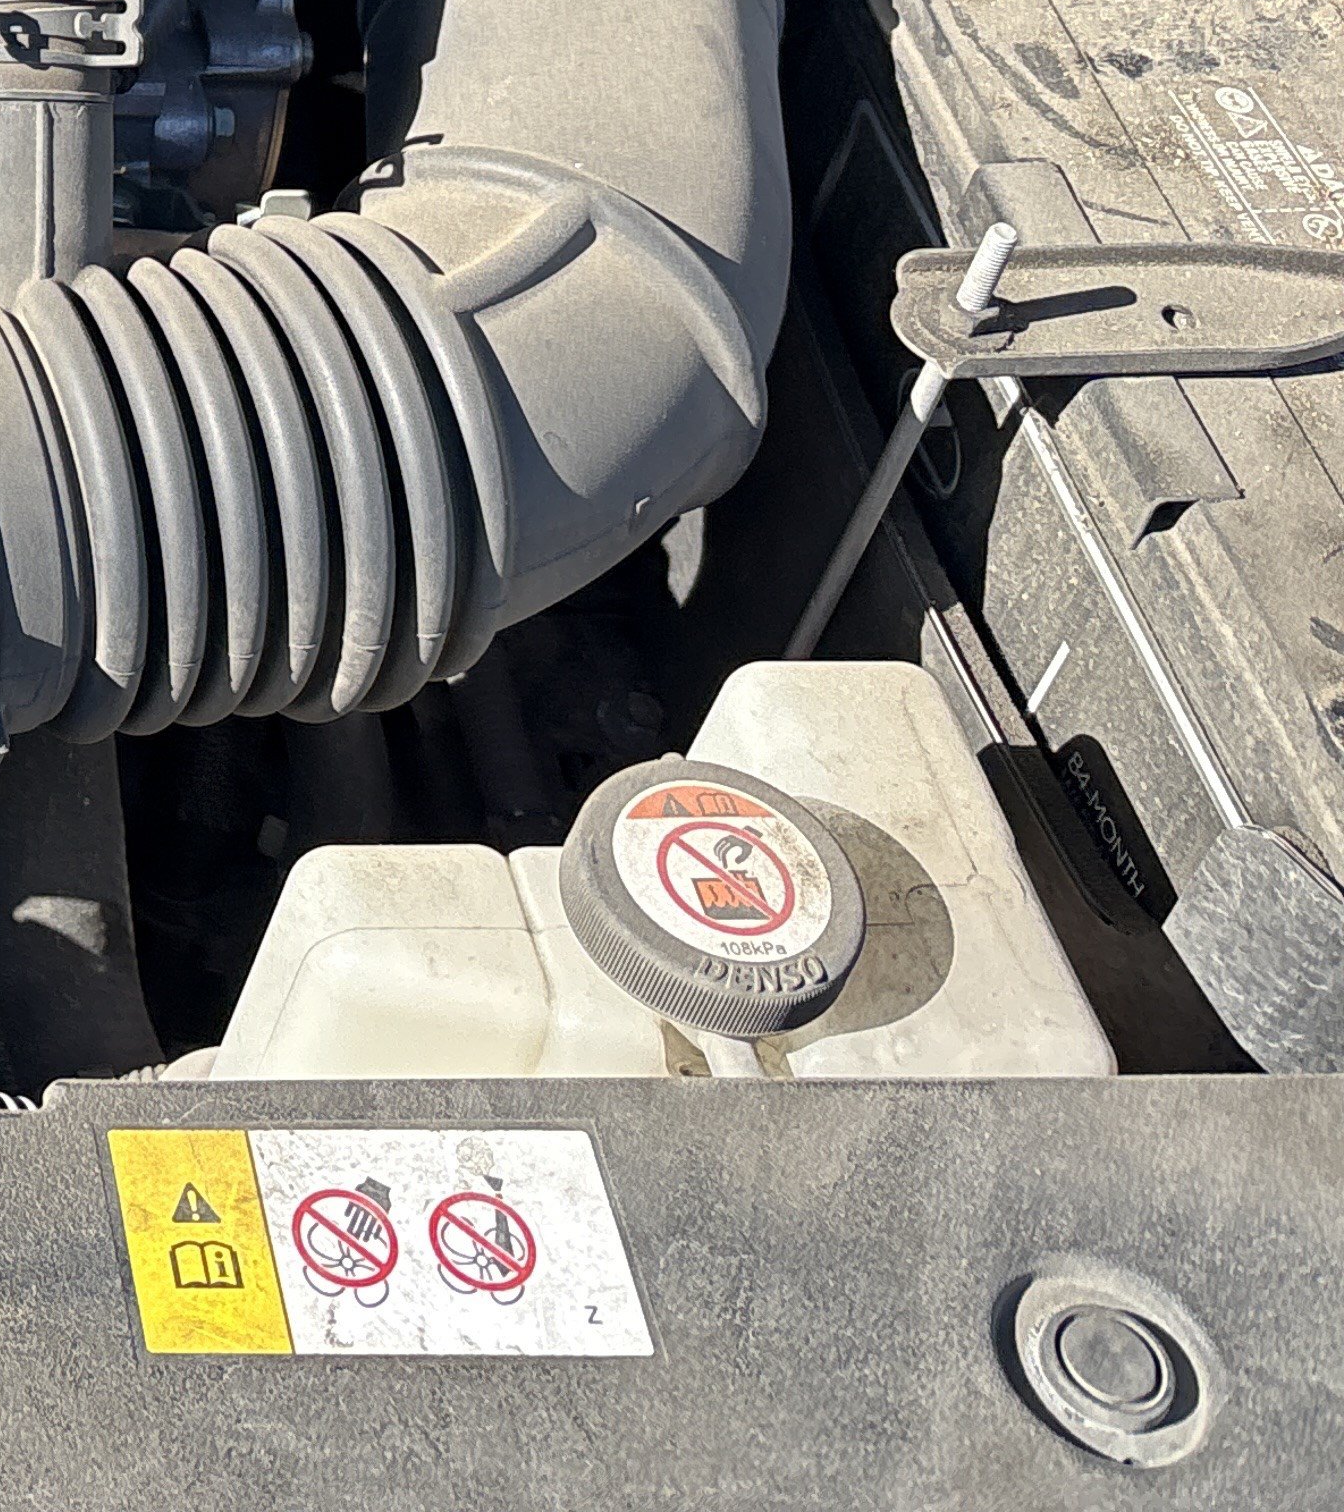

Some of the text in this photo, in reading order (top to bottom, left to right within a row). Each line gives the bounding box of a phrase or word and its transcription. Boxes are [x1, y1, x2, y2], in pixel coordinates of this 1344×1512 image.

[1168, 114, 1191, 133] DO
[1180, 133, 1208, 156] NOT
[1213, 180, 1244, 211] KEEP
[720, 940, 788, 956] 108kPa
[694, 954, 829, 993] DENSO
